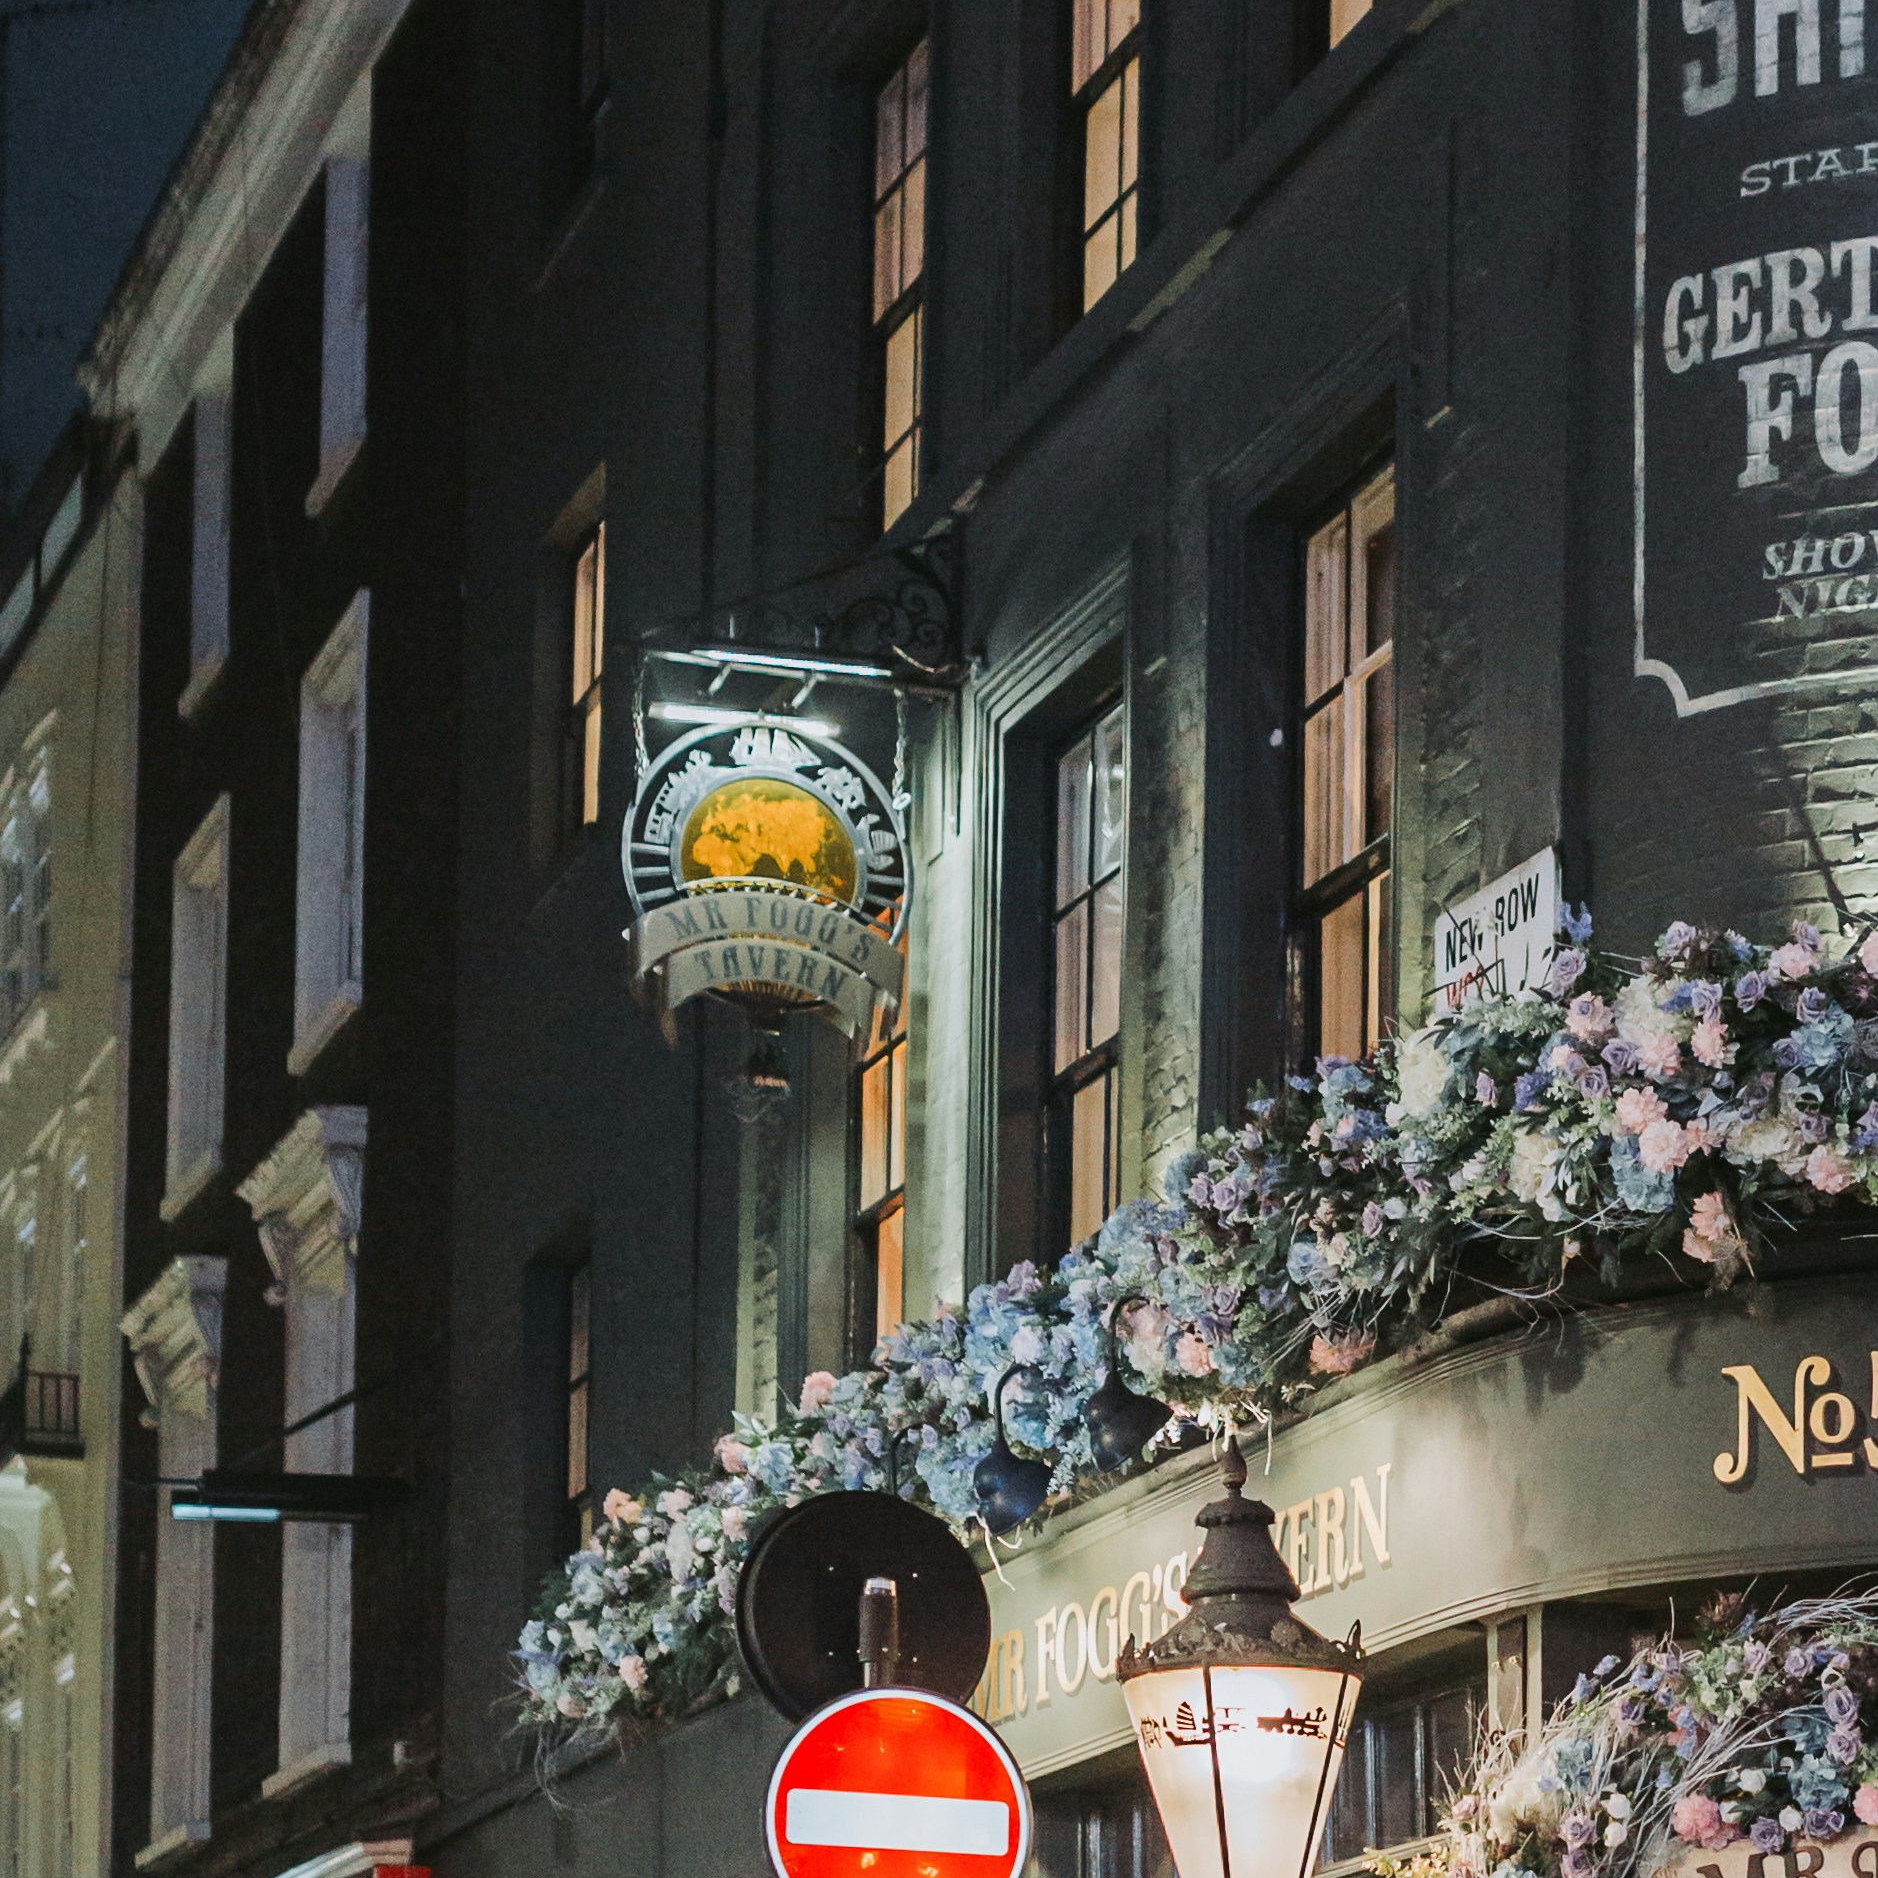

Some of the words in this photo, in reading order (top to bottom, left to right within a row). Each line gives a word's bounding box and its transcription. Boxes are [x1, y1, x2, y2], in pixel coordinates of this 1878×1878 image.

[664, 897, 728, 941] MR
[1495, 873, 1540, 937] ROW
[693, 944, 848, 1001] TAVERN
